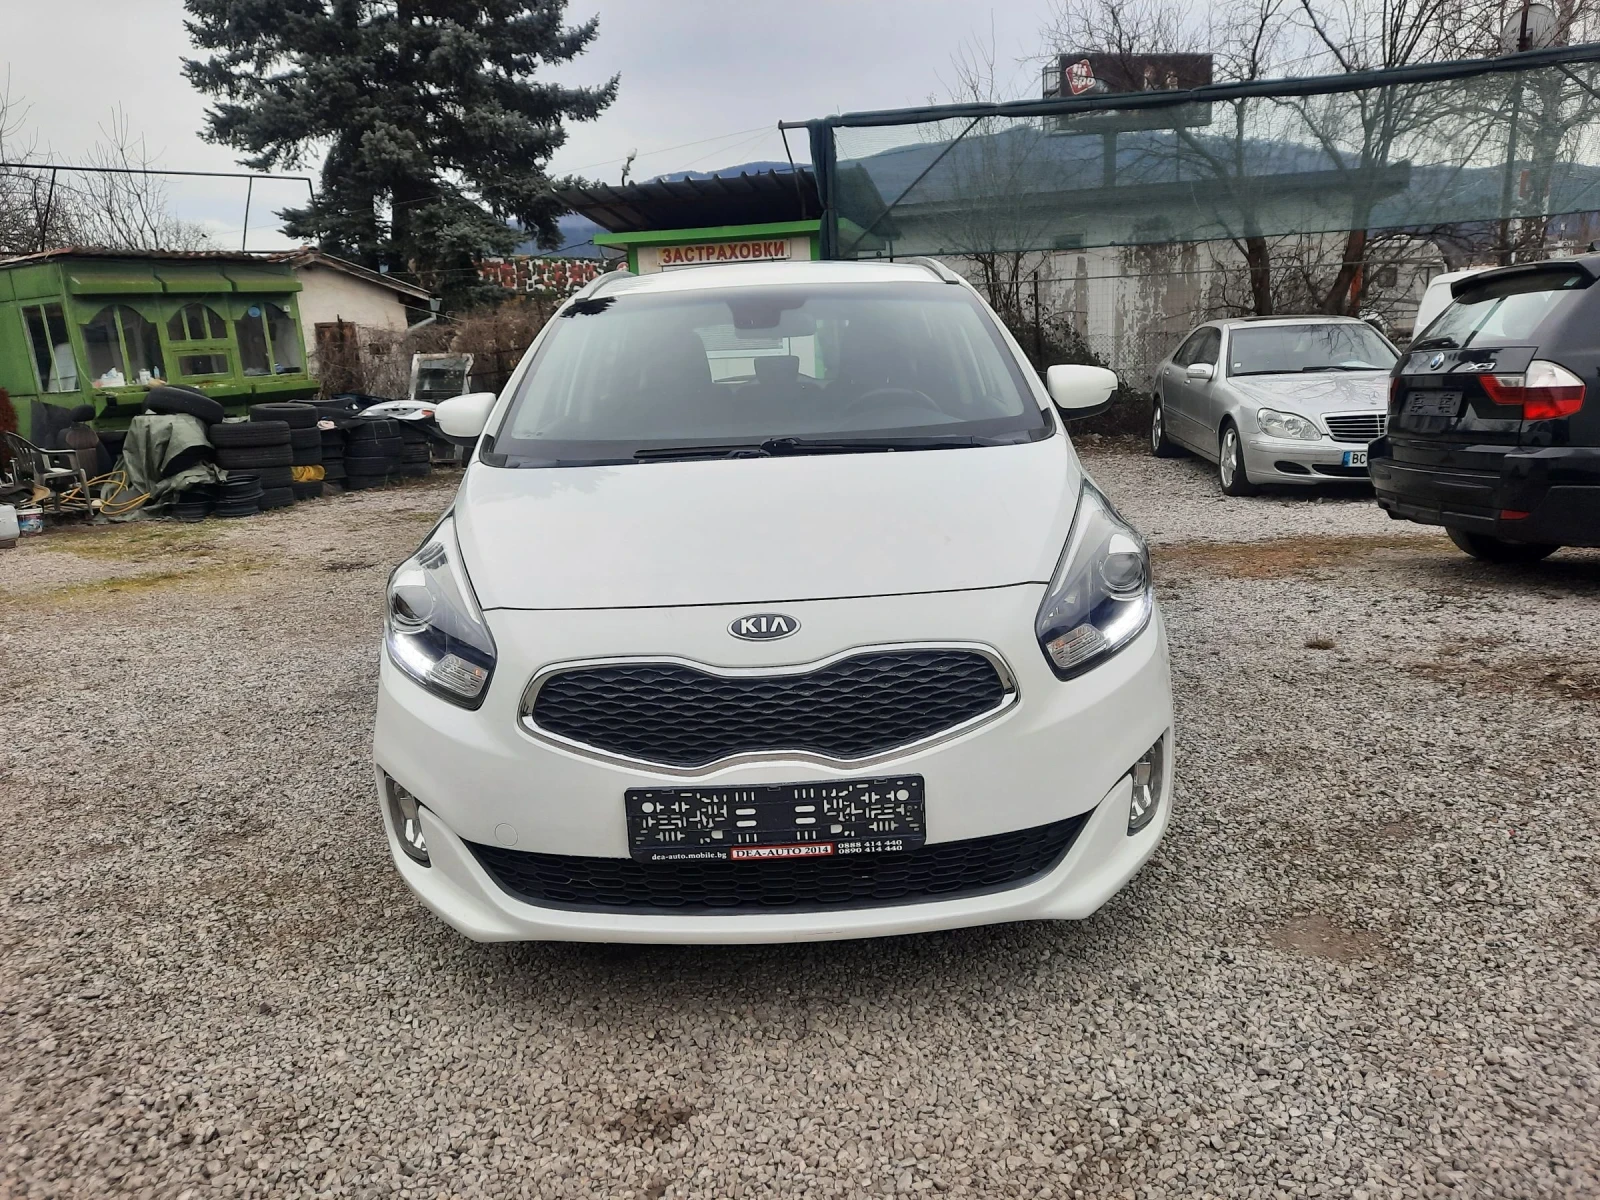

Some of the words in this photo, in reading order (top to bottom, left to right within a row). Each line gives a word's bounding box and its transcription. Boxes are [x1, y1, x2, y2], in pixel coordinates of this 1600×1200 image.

[662, 241, 785, 263] ЗАСТРАХОВКИ
[1466, 362, 1496, 370] X3
[740, 616, 789, 634] KIA
[651, 851, 727, 860] dea-auto.mobile.bg
[735, 847, 802, 857] DEA-AUTO
[805, 846, 829, 854] 2014
